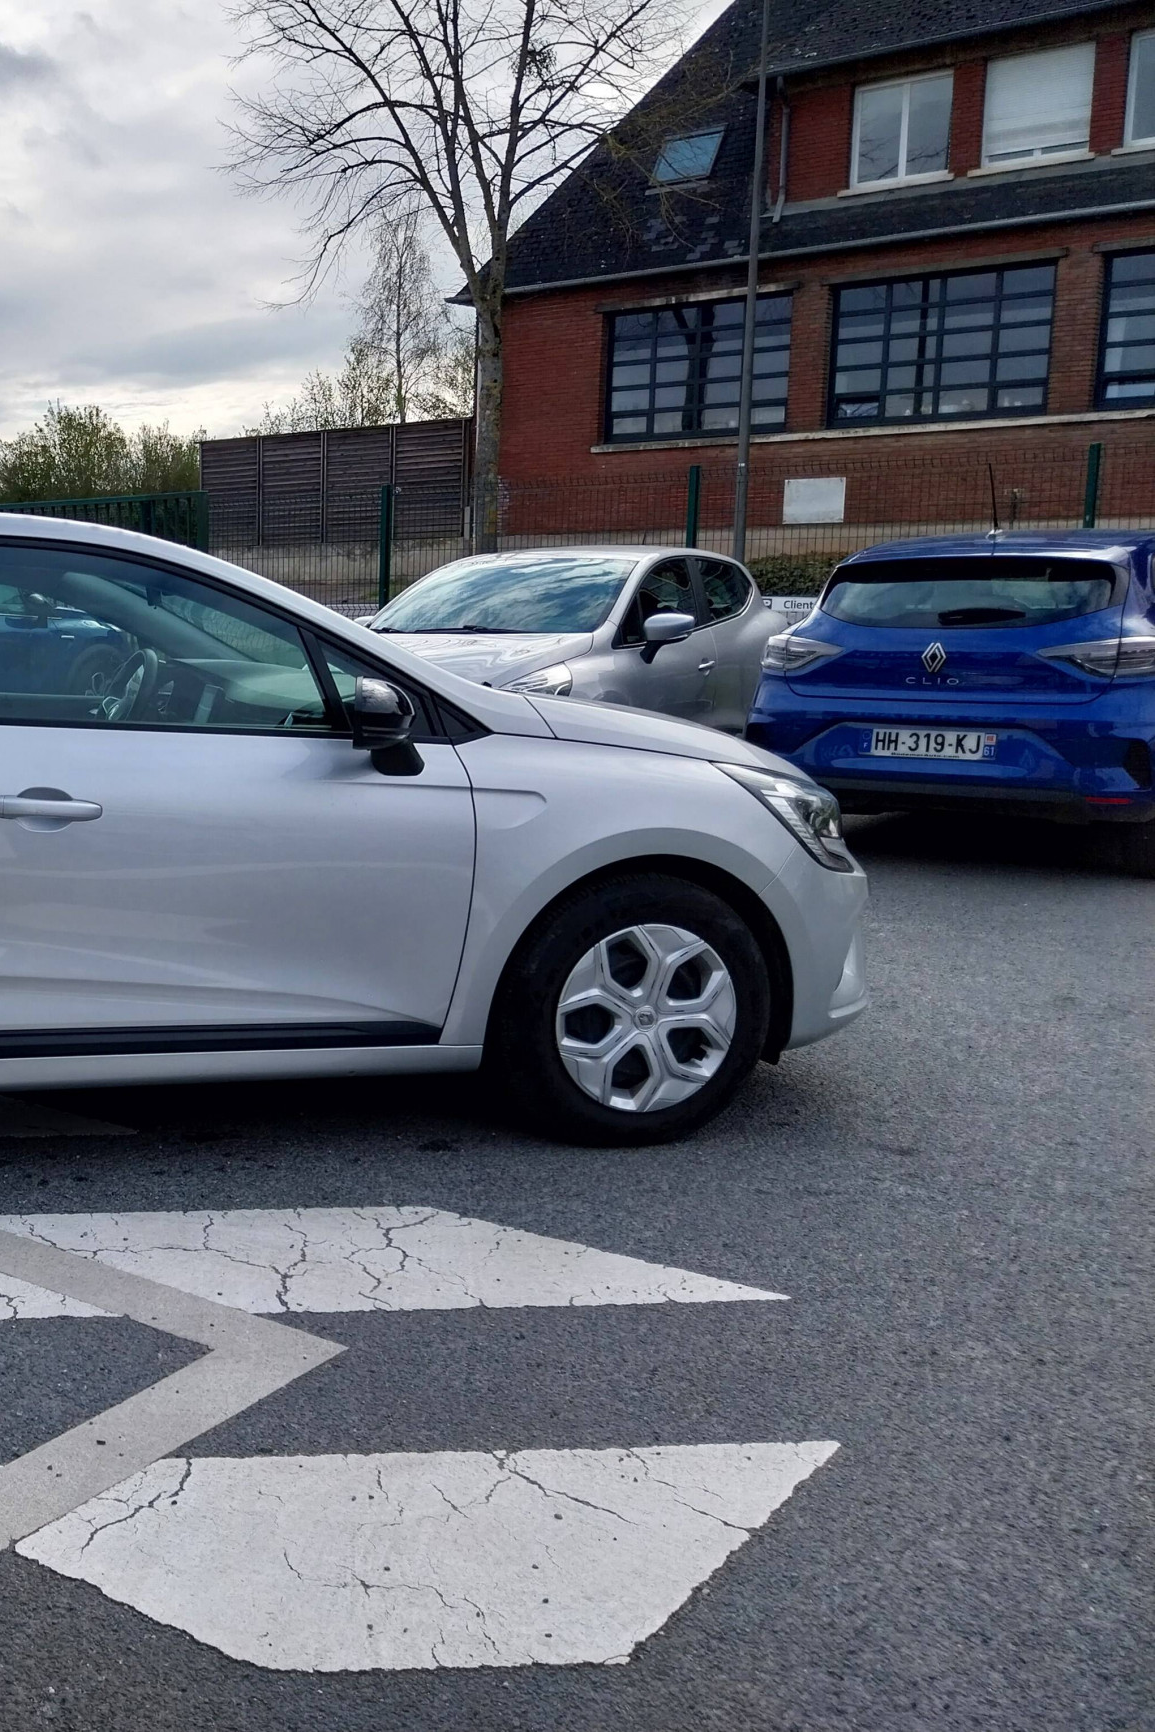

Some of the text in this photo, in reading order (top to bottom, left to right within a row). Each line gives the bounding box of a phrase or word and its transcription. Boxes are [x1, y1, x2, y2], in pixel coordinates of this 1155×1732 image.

[905, 676, 959, 686] CLIO
[874, 731, 982, 755] HH-319-KJ
[983, 746, 995, 757] 61
